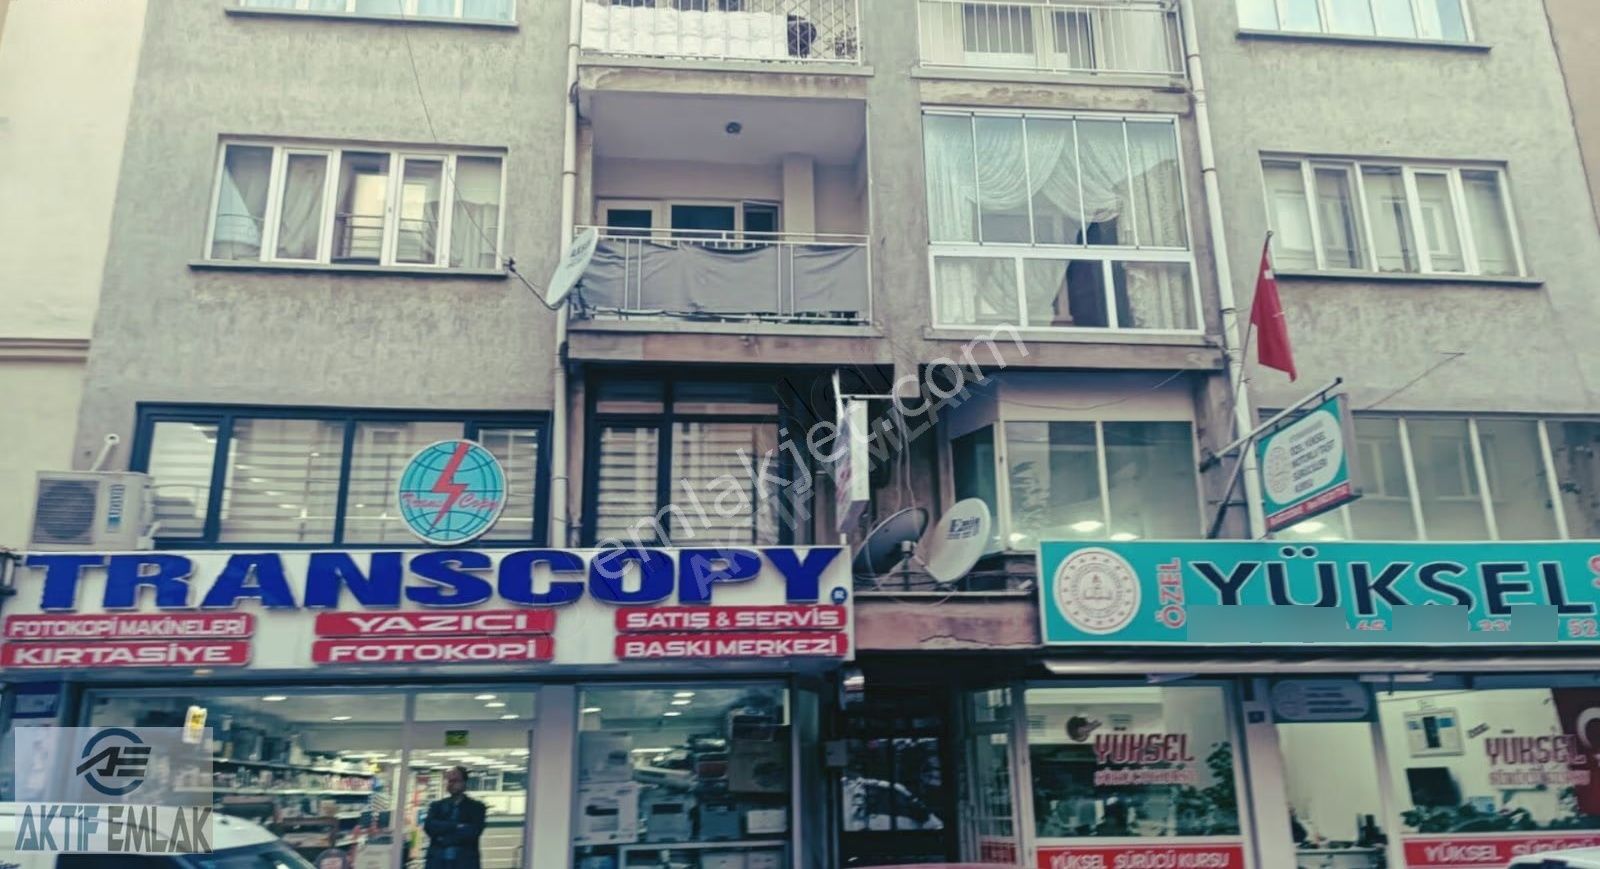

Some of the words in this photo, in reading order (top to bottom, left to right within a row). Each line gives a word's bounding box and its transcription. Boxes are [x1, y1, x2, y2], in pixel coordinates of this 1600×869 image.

[25, 548, 843, 612] TRANSCOPY
[1189, 546, 1597, 616] YÜKSEL
[1156, 558, 1186, 628] ÖZEL
[10, 618, 117, 637] FOTOKOPİ
[120, 616, 247, 636] MAKİNELERİ
[347, 614, 527, 633] YAZICI
[626, 611, 710, 629] SATIŞ
[716, 612, 729, 628] &
[735, 609, 839, 628] SERVİS
[14, 644, 234, 664] KIRTASİYE
[329, 640, 536, 662] FOTOKOPİ
[625, 640, 710, 658] BASKI
[716, 635, 838, 656] MERKEZİ
[1094, 726, 1195, 764] YÜKSEL
[1485, 729, 1588, 765] YÜKSEL
[1050, 851, 1108, 869] YÜKSEL
[1177, 853, 1230, 868] KURSU
[1424, 840, 1504, 862] YÜKSEL
